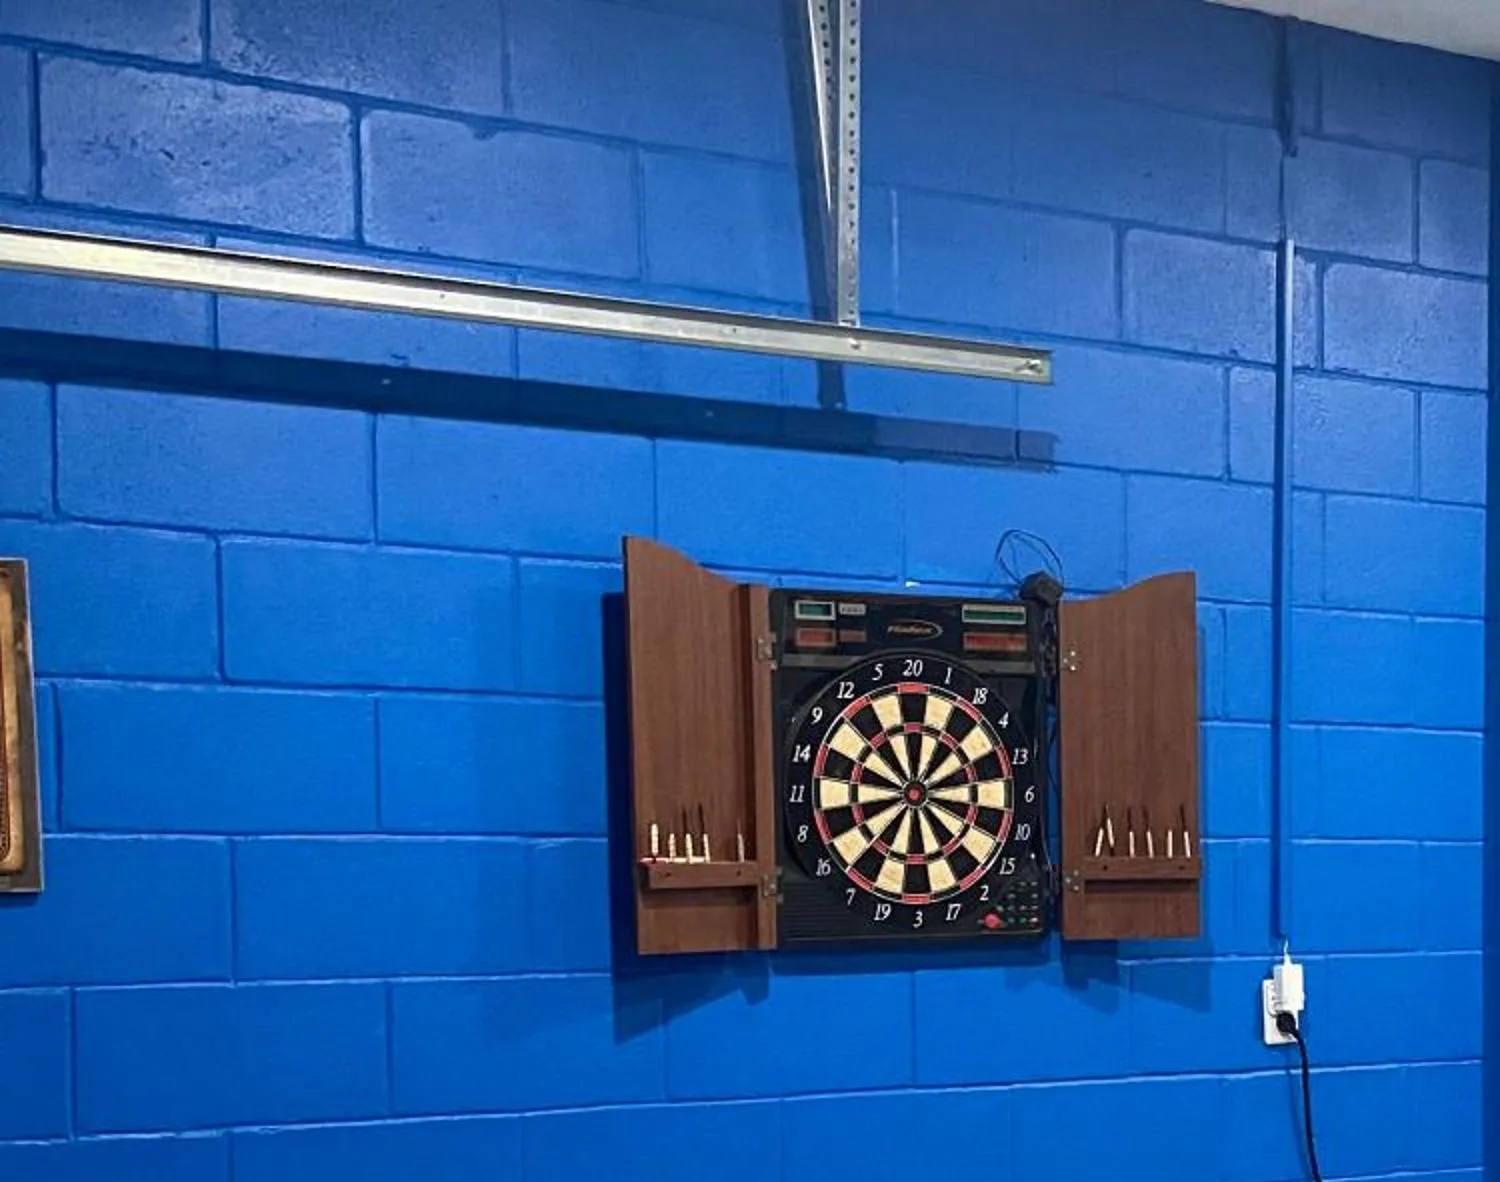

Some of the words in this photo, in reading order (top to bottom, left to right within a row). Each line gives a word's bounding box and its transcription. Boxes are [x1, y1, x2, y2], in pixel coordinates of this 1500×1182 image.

[872, 664, 883, 680] 5
[903, 660, 923, 676] 20
[945, 667, 952, 684] 1
[837, 682, 854, 699] 12
[972, 688, 988, 704] 18
[812, 707, 823, 724] 9
[998, 712, 1008, 728] 4
[793, 745, 810, 762] 14
[1012, 748, 1028, 764] 13
[790, 785, 804, 802] 11
[1025, 786, 1034, 802] 6
[797, 825, 808, 842] 8
[1015, 824, 1030, 840] 10
[816, 859, 831, 876] 16
[1000, 858, 1015, 874] 15
[847, 888, 855, 905] 7
[980, 885, 989, 901] 2
[874, 904, 891, 920] 19
[913, 911, 922, 928] 3
[946, 903, 961, 920] 17
